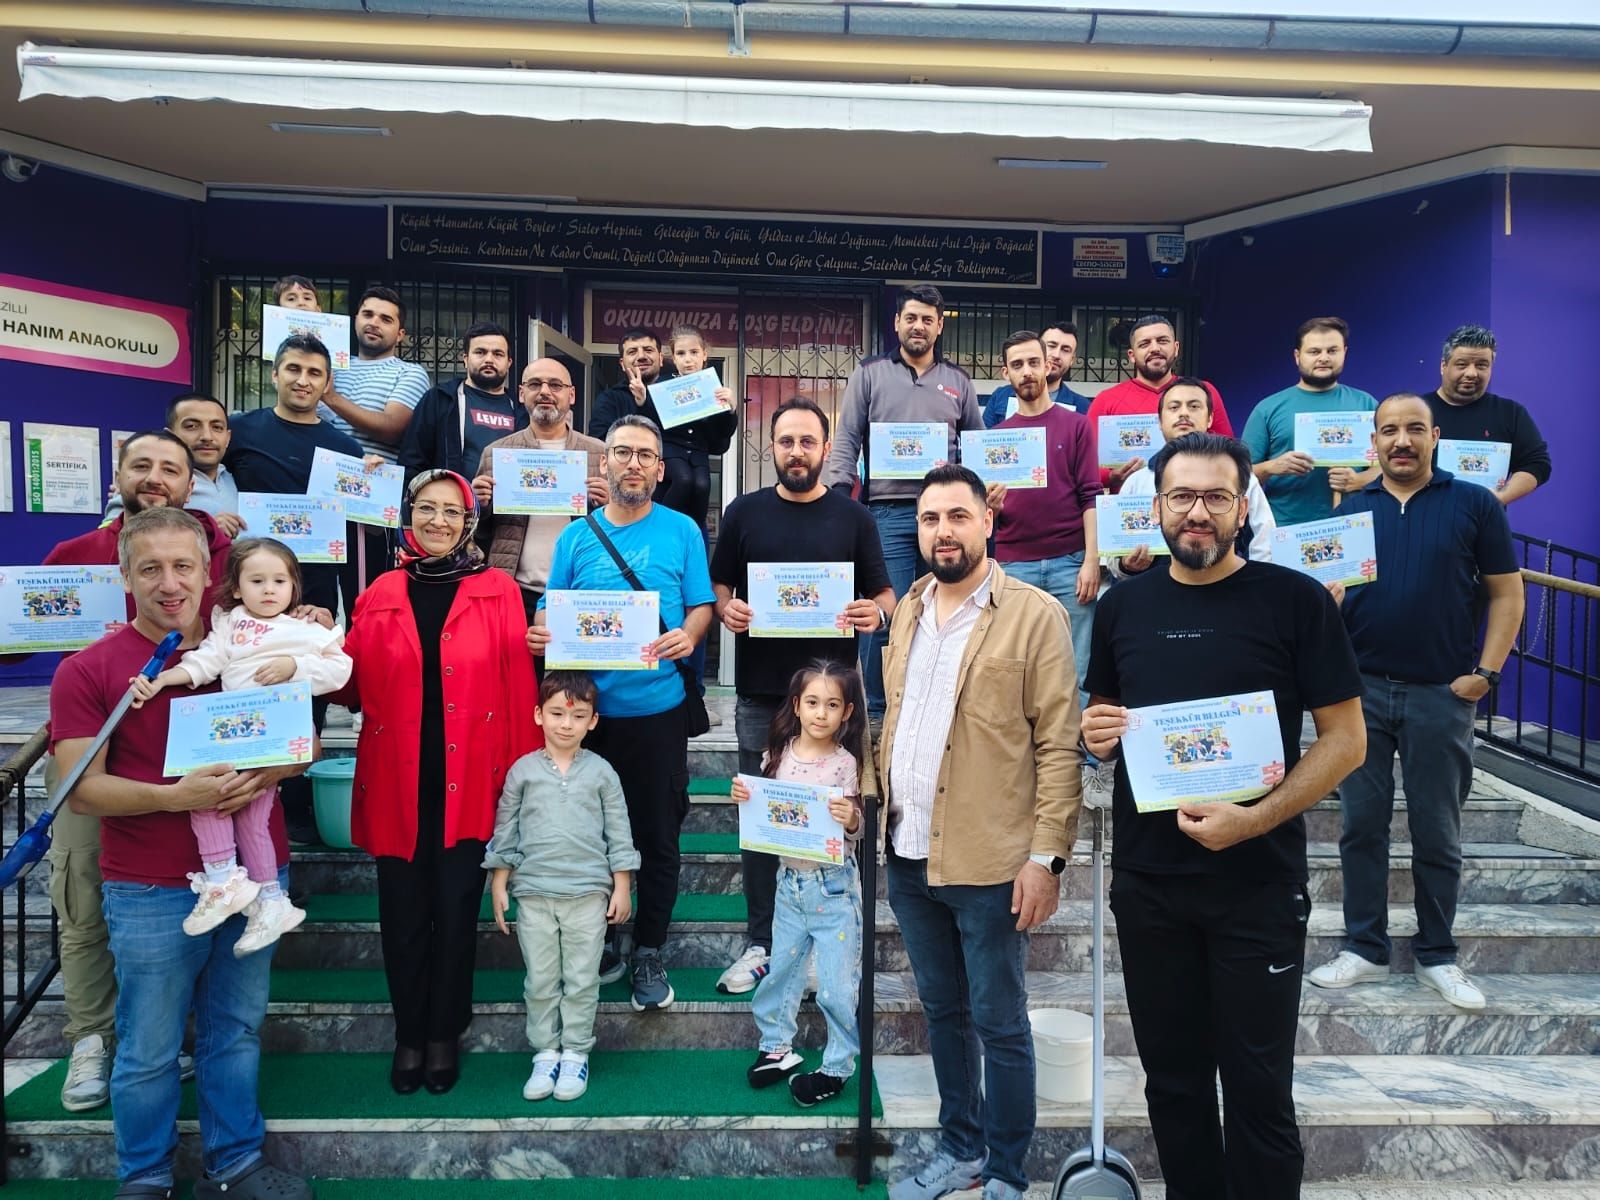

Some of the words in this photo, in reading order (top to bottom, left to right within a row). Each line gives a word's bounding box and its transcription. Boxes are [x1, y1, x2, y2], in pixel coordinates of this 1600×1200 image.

[400, 213, 431, 230] Küçük
[432, 217, 484, 231] Hanımlar,
[487, 216, 518, 235] Küçük
[566, 220, 599, 236] Sizler
[602, 221, 642, 241] Hepiniz
[654, 223, 700, 244] Geleceğin
[703, 225, 721, 240] Bir
[725, 226, 752, 244] Gülü,
[757, 227, 793, 245] Yıldızı
[795, 234, 805, 243] ve
[808, 226, 837, 246] İkbal
[889, 233, 938, 252] Memleketi
[940, 235, 961, 252] Asıl
[963, 235, 991, 256] Işığa
[995, 236, 1035, 256] Boğacak
[400, 237, 425, 254] Olan
[426, 238, 472, 256] Sizsiniz.
[477, 240, 528, 258] Kendinizin
[529, 242, 545, 260] Ne
[550, 243, 579, 260] Kadar
[583, 242, 620, 262] Önemli,
[622, 248, 656, 267] Değerli
[657, 249, 710, 268] Olduğunuzu
[712, 249, 760, 268] Düşünerek
[766, 251, 787, 267] Ona
[790, 253, 813, 270] Göre
[861, 255, 908, 272] Sizlerden
[911, 257, 931, 275] Çok
[931, 258, 952, 277] Şey
[956, 259, 1008, 278] Bekliyoruz.
[604, 308, 722, 331] OKULUMUZA
[3, 319, 63, 341] HANIM
[68, 330, 158, 355] ANAOKULU
[31, 450, 41, 490] 14001:2015
[46, 460, 88, 470] SERTİFİKA
[33, 494, 41, 505] ISO
[1153, 712, 1201, 728] TEŞEKKÜR
[1202, 705, 1241, 720] BELGESİ
